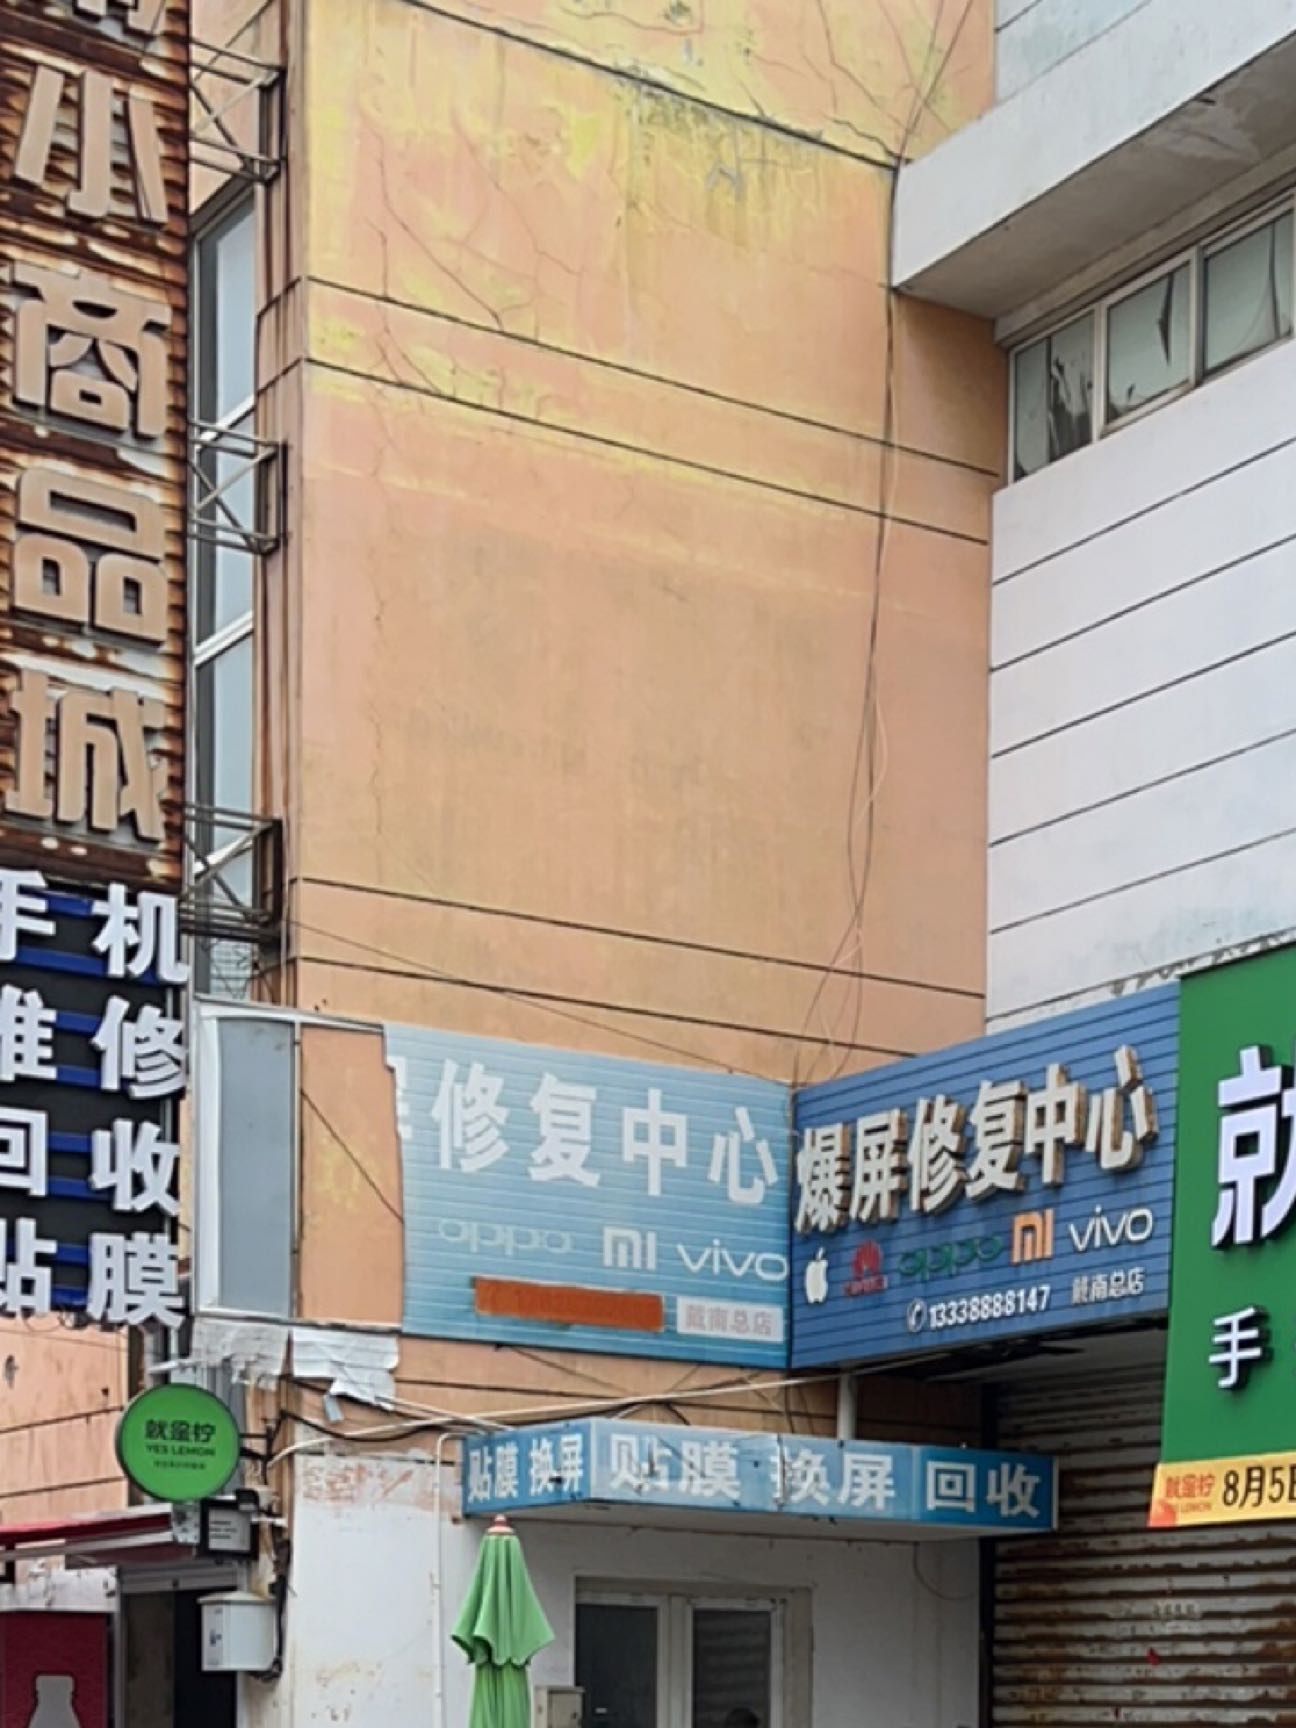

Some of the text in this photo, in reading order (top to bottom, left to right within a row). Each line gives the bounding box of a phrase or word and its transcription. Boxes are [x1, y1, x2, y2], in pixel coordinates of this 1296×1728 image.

[6, 0, 171, 842] 小商品城
[0, 869, 190, 984] 手机
[0, 1107, 180, 1215] 回收
[795, 1044, 1159, 1234] 爆屏修复中心
[676, 1238, 789, 1282] vivo
[1068, 1204, 1154, 1253] vivo
[468, 1432, 584, 1502] 贴膜 换屏
[608, 1432, 1042, 1519] 贴膜 换屏 回收
